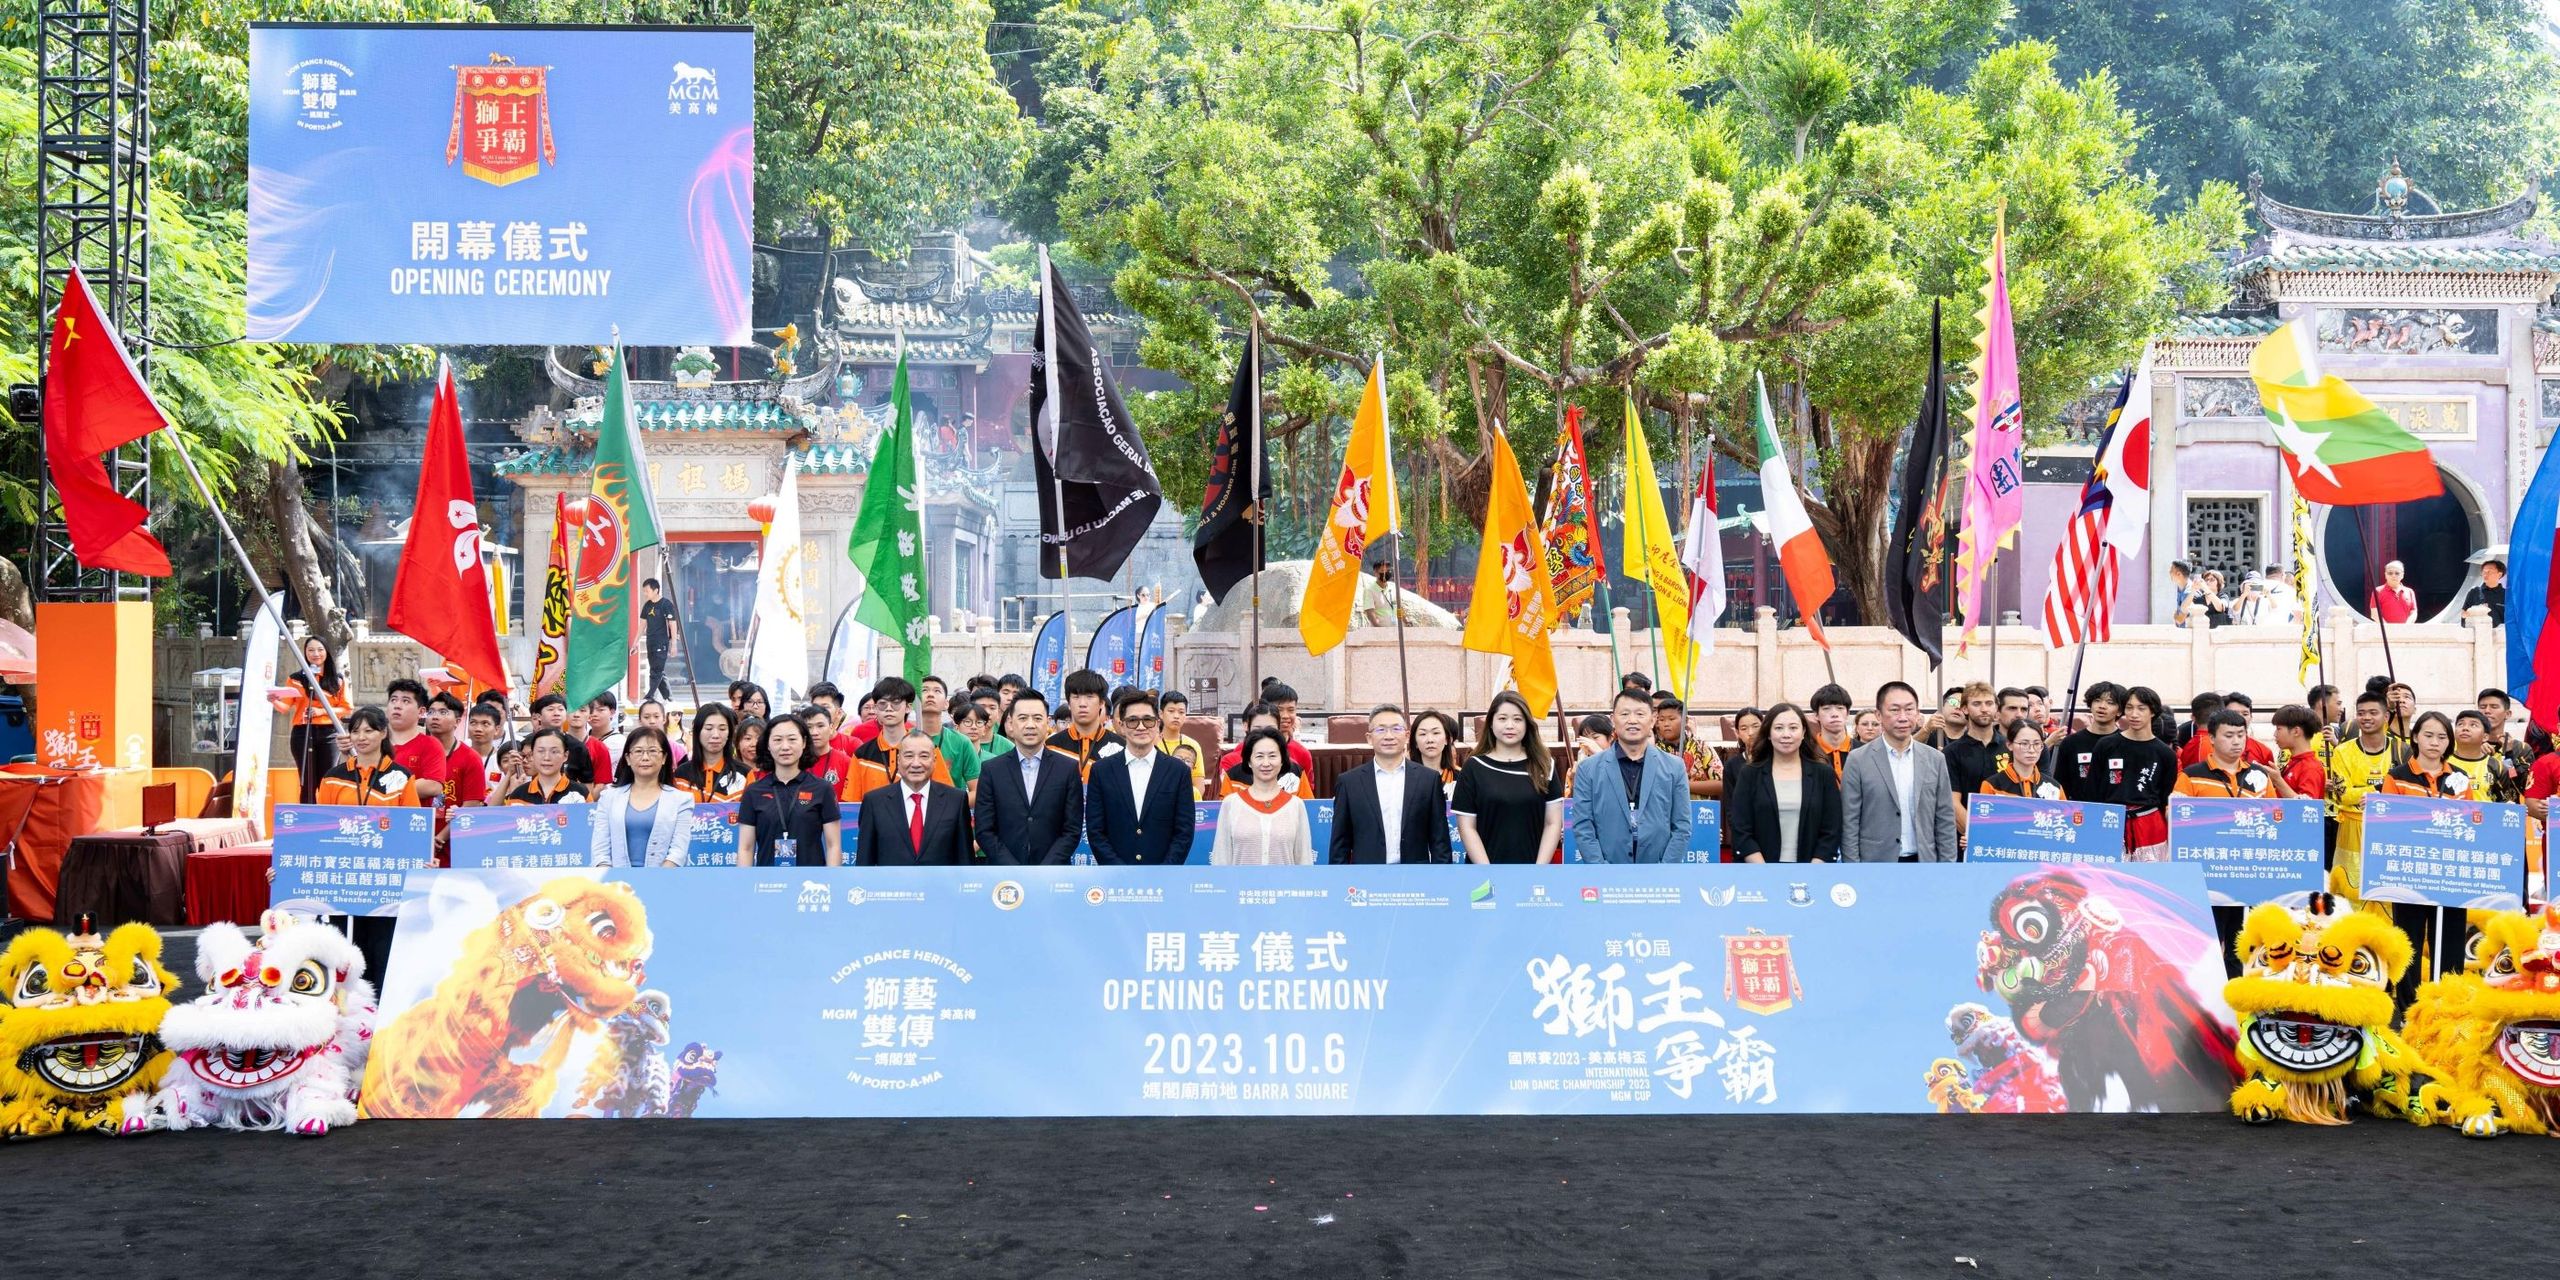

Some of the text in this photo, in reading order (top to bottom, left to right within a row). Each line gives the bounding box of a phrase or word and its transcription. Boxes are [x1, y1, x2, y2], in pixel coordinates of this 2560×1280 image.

[302, 73, 337, 90] 獅藝
[302, 92, 337, 110] 雙傳
[668, 85, 719, 100] MGM
[475, 100, 528, 124] 獅王
[669, 102, 718, 115] 美高梅
[476, 128, 528, 153] 爭霸
[411, 221, 589, 262] 開幕儀式
[390, 268, 611, 296] OPENING CEREMONY
[1090, 347, 1144, 471] ASSOCIAÇÃO GERAL
[1664, 576, 1687, 597] BARONG
[1672, 594, 1688, 609] LION
[279, 854, 425, 870] 深圳市寶安區福海街道
[481, 852, 583, 868] 中國香港南獅隊
[301, 871, 401, 886] 橋頭社區醒獅團
[2379, 874, 2401, 882] Dragon
[341, 889, 368, 898] Troupe
[381, 889, 403, 898] Qiaot
[797, 894, 831, 904] MGM
[1145, 930, 1349, 974] 開幕儀式
[1605, 939, 1671, 958] 第10屆
[831, 949, 973, 985] LION DANCE HERITAGE
[1741, 958, 1780, 975] 獅王
[864, 976, 939, 1011] 獅藝
[1103, 979, 1389, 1011] OPENING CEREMONY
[1526, 953, 1726, 1048] 獅王
[822, 1008, 858, 1020] MGM
[940, 1007, 976, 1021] 美高梅
[860, 1014, 936, 1048] 雙傳
[874, 1052, 918, 1066] 媽閣堂
[1143, 1033, 1346, 1074] 2023.10.6
[1585, 1067, 1650, 1078] INTERNATIONAL
[1653, 1025, 1778, 1105] 爭霸
[847, 1070, 944, 1090] IN PORTO-A-MA
[1510, 1079, 1650, 1090] LION DANCE CHAMPIONSHIP 2023
[1142, 1081, 1349, 1101] 媽閣廟前地 BARRA SQUARE
[1611, 1091, 1651, 1102] MGM CUP
